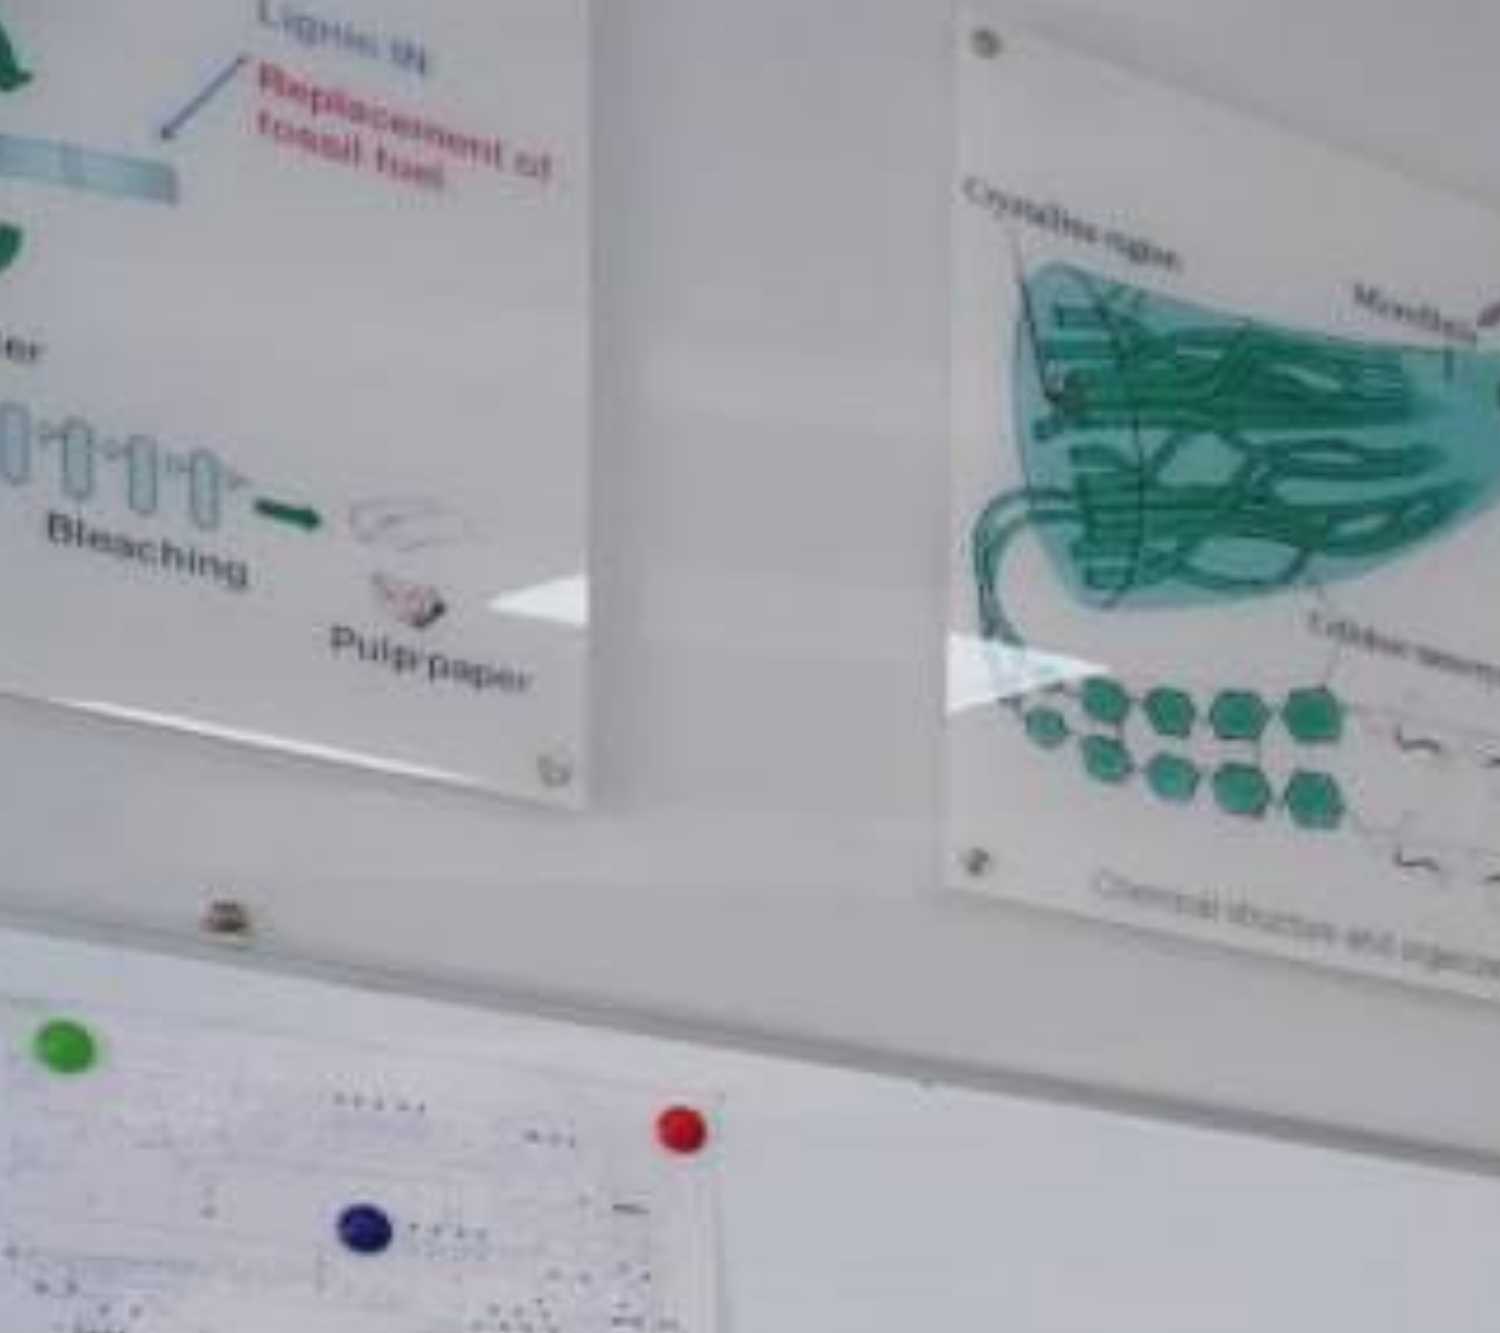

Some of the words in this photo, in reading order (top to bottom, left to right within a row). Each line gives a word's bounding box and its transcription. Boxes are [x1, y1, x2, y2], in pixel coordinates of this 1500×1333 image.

[258, 60, 505, 173] Replacement
[513, 152, 553, 184] of
[258, 110, 362, 170] fossil
[376, 146, 446, 192] fuel
[48, 511, 250, 590] Bleaching
